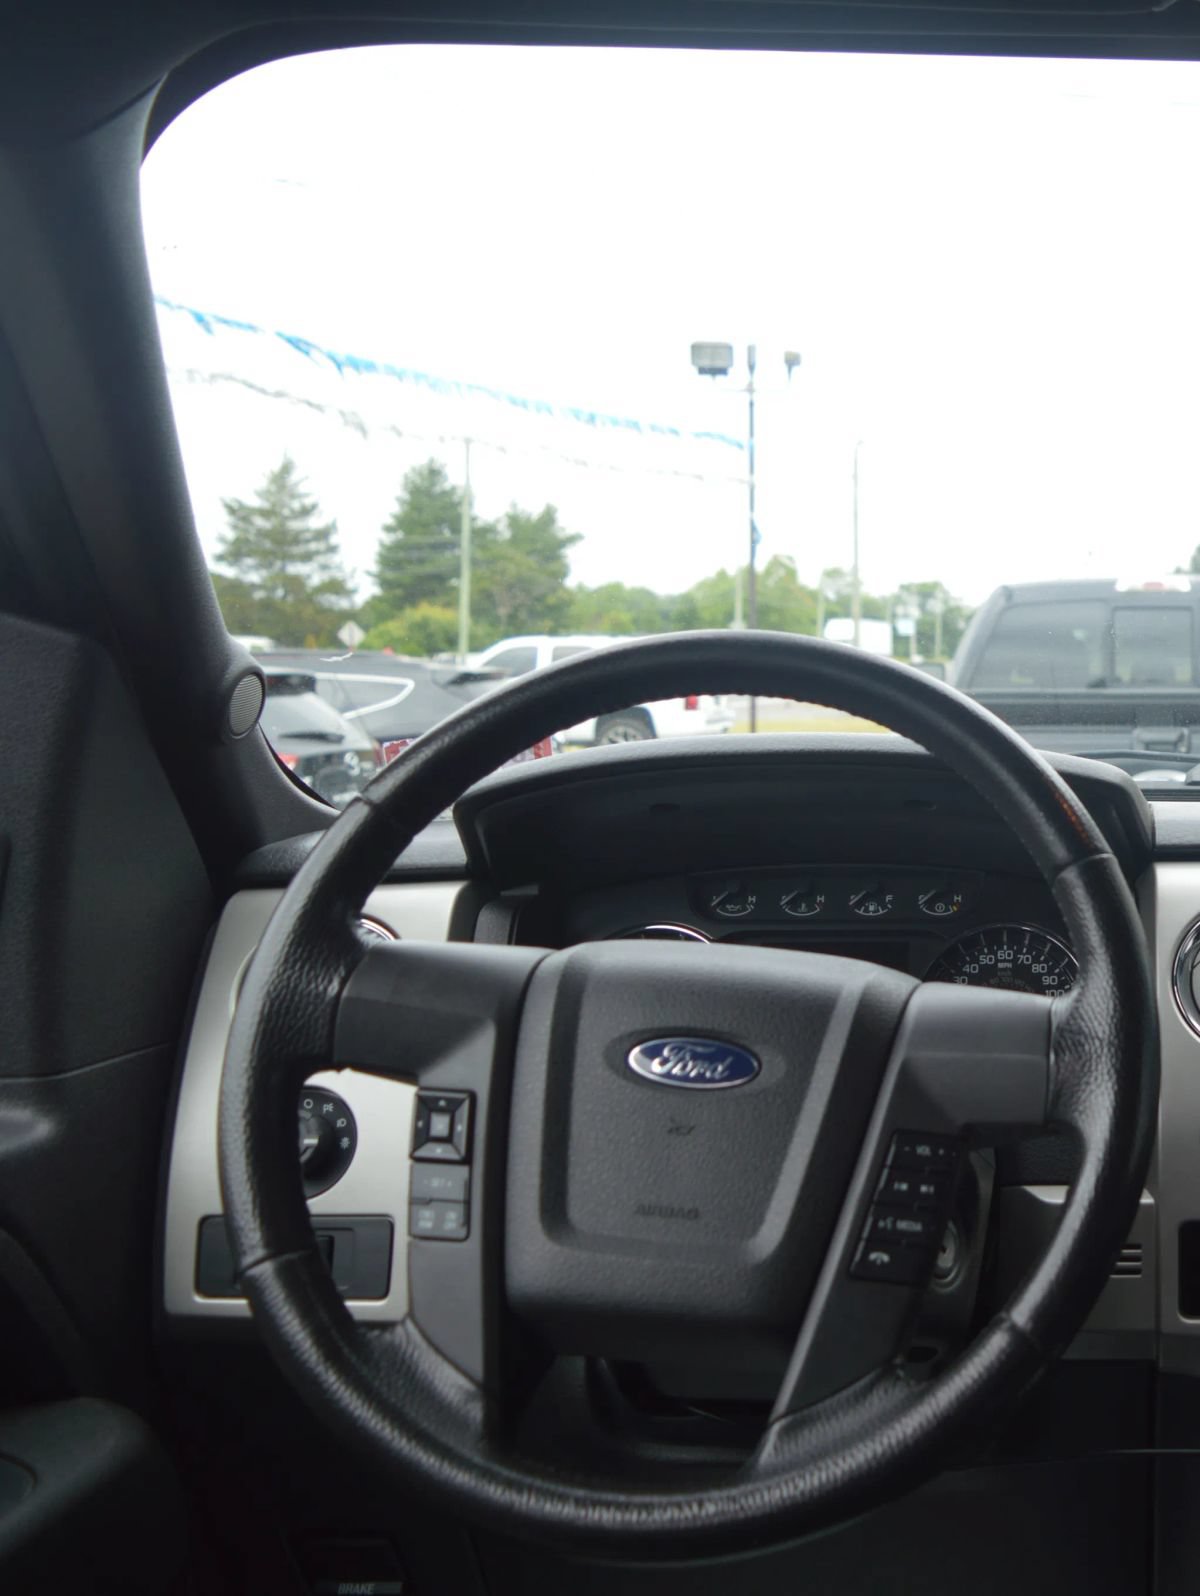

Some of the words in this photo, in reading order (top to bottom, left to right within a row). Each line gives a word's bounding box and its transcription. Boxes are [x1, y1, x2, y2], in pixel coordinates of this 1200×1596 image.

[978, 954, 995, 965] 50
[997, 949, 1014, 960] 60
[1017, 954, 1032, 965] 70
[962, 963, 979, 974] 40
[1031, 963, 1048, 974] 80
[953, 975, 968, 985] 30
[1041, 975, 1058, 985] 90
[651, 1043, 734, 1080] Ford
[337, 1583, 376, 1596] BRAKE
